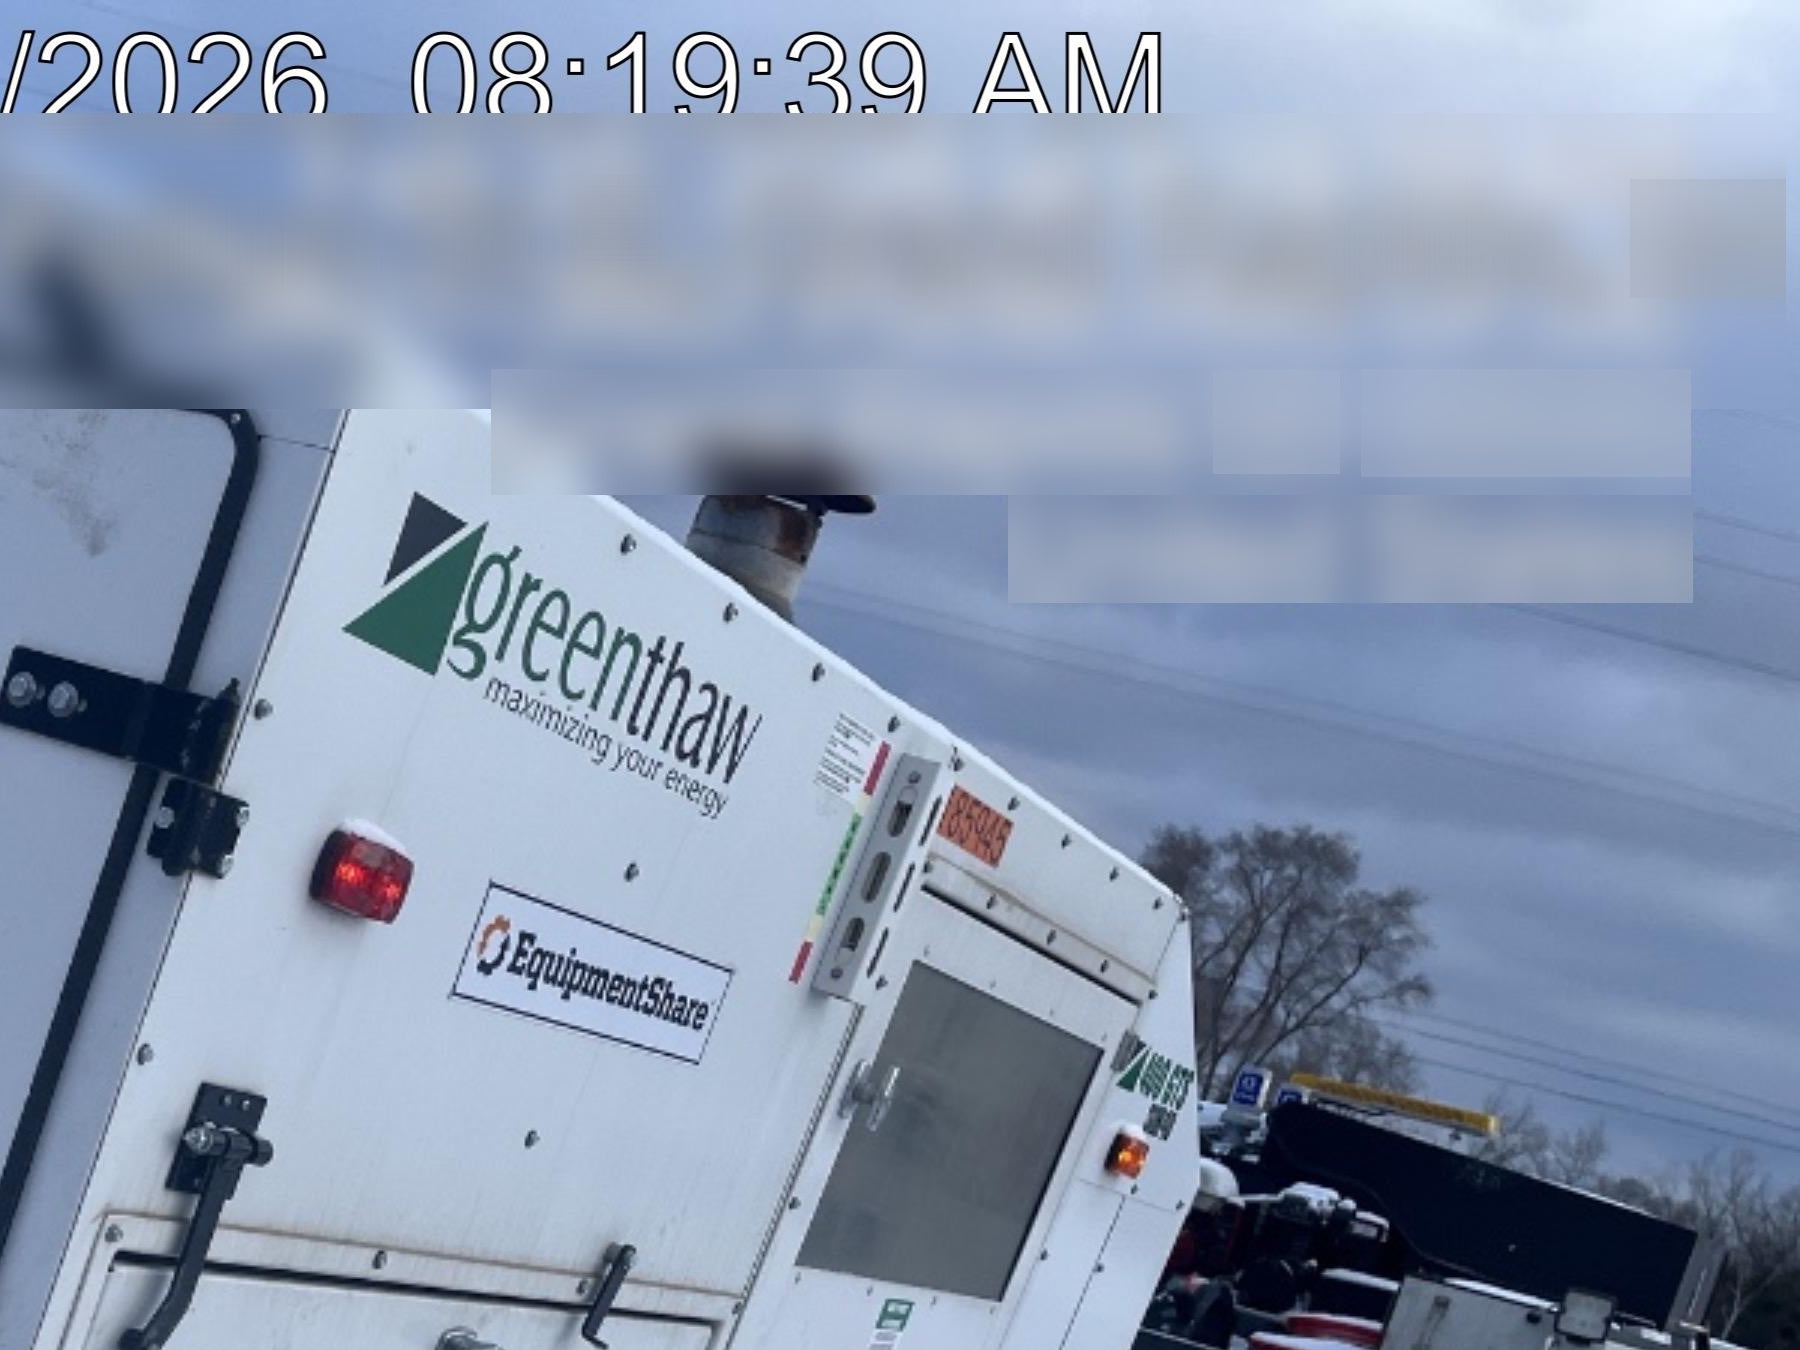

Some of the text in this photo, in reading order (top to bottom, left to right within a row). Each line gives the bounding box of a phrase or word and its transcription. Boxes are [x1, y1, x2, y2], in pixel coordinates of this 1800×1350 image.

[446, 545, 763, 785] greenthaw
[482, 674, 729, 820] maximizing your energy
[505, 929, 710, 1030] EquipmentShare
